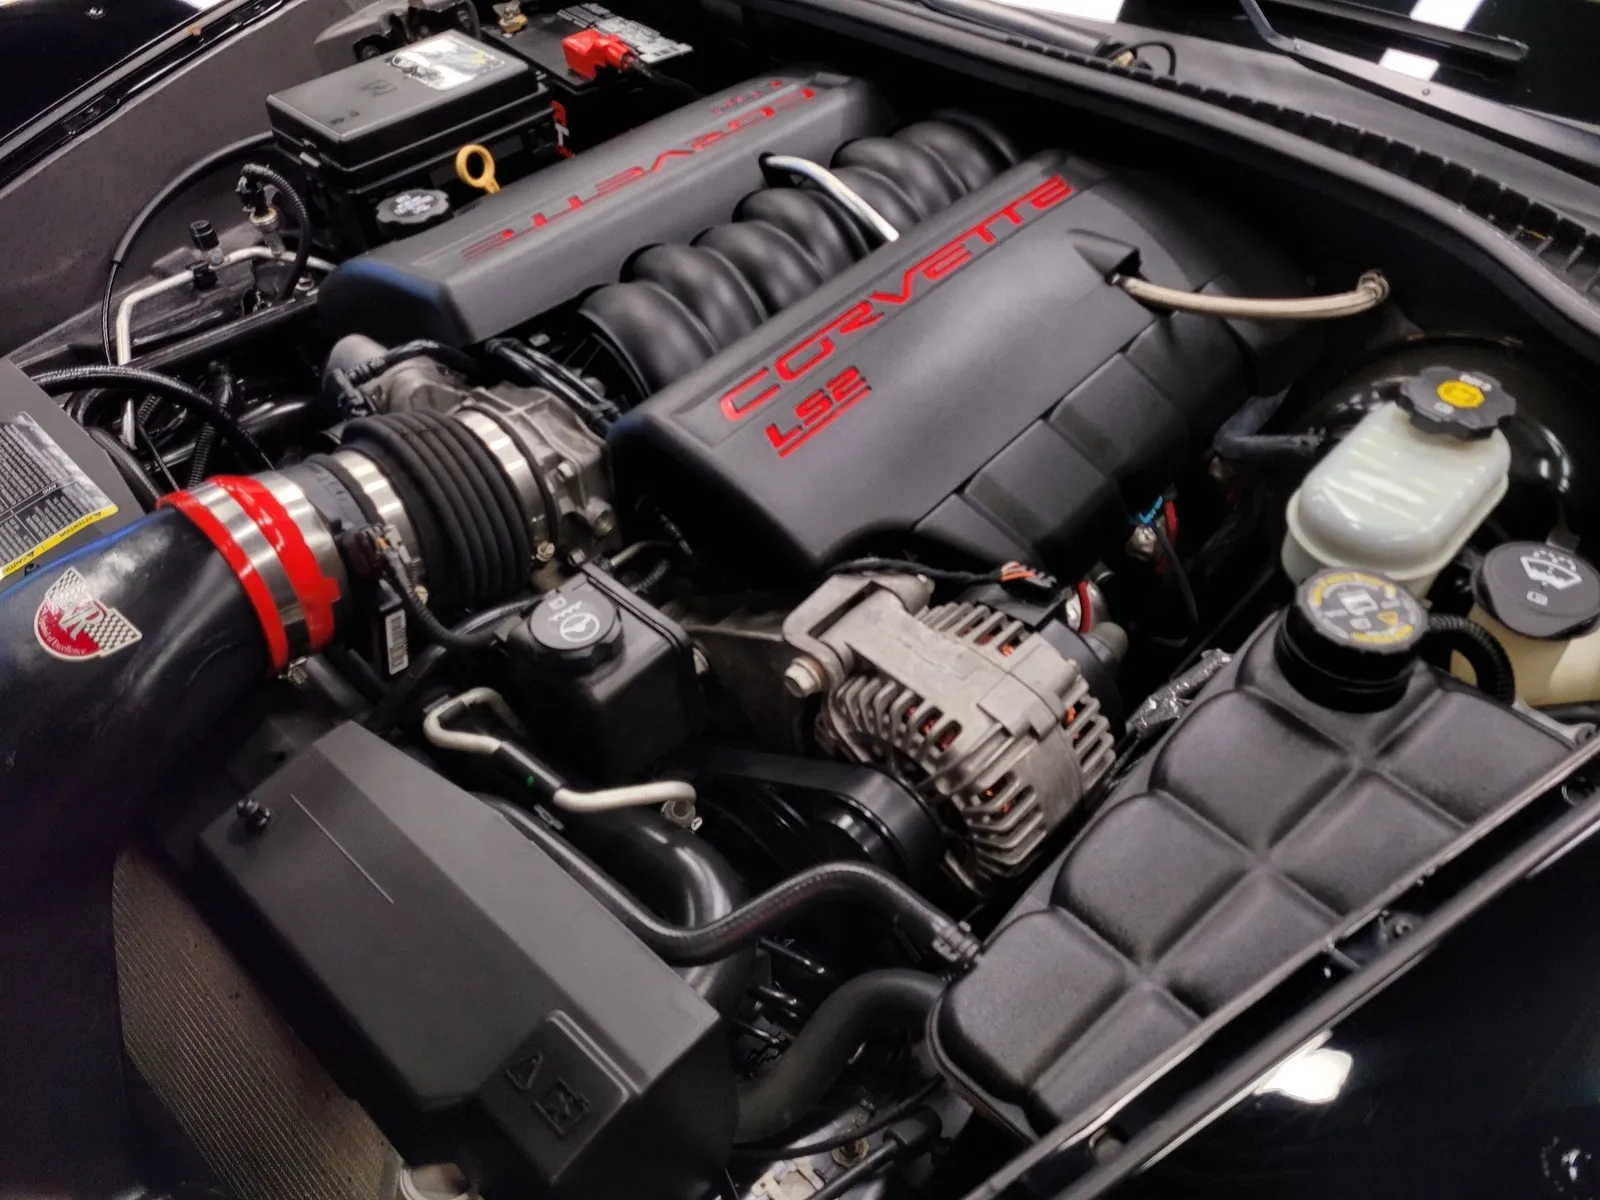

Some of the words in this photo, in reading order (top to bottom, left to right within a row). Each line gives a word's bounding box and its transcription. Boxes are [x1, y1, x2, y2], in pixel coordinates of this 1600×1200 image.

[719, 174, 1074, 421] CORVETTE
[765, 366, 870, 453] LS2
[2, 556, 28, 574] CAUTIO
